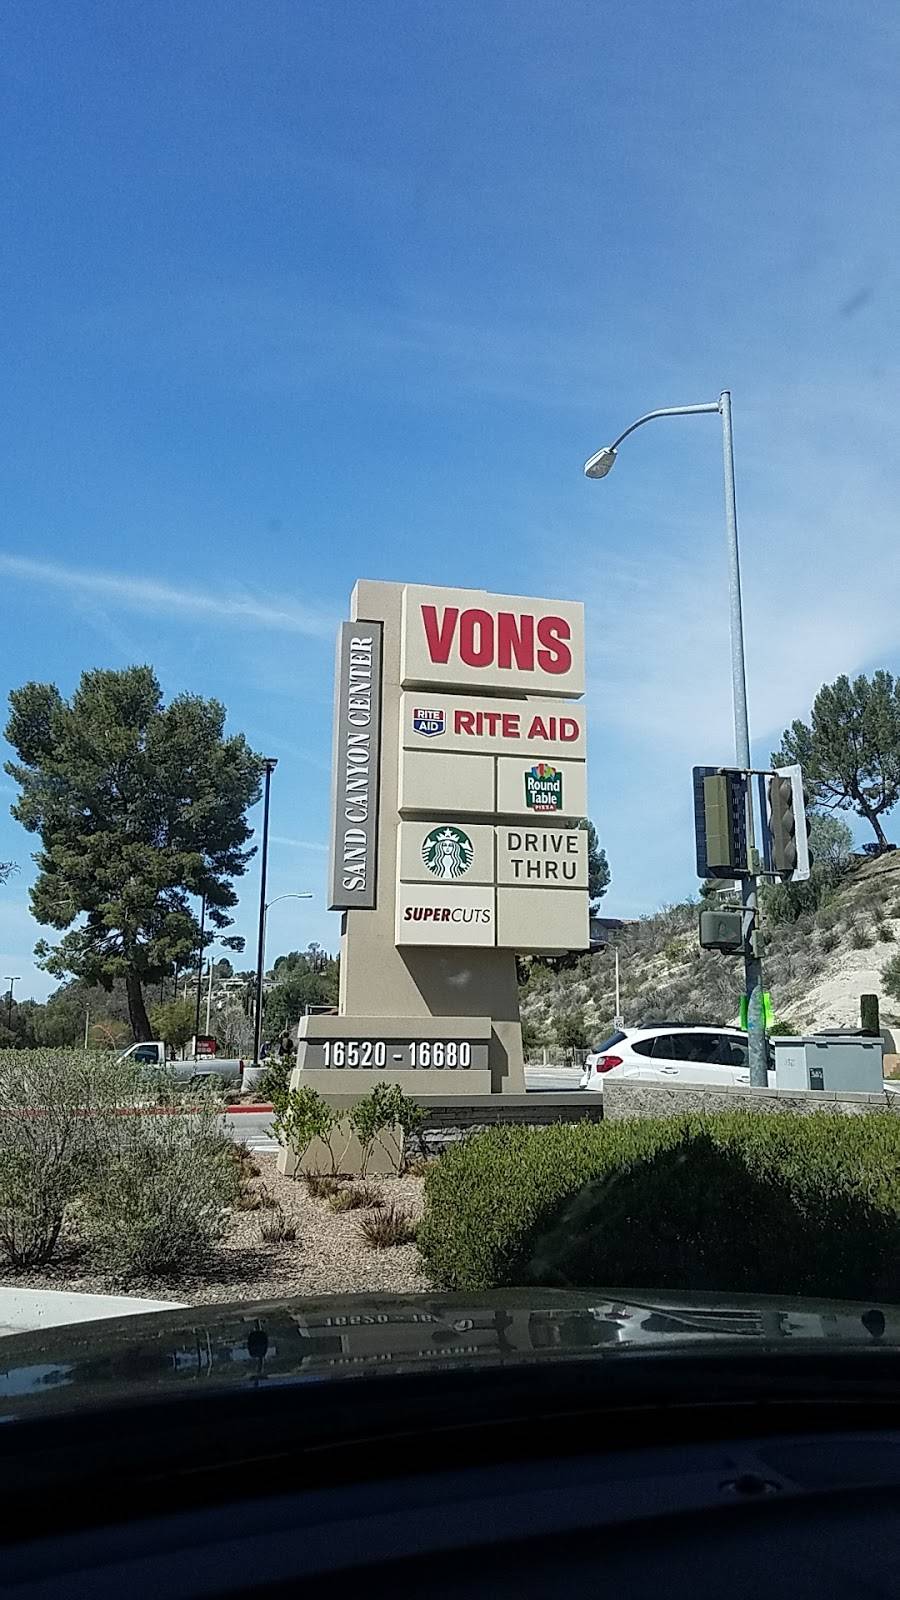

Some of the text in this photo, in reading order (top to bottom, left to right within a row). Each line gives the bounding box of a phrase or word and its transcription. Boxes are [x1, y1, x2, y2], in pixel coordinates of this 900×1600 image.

[421, 604, 573, 676] VONS
[417, 710, 440, 720] RITE
[418, 720, 439, 731] AID
[454, 710, 580, 742] RITE AID
[343, 637, 373, 892] SAND CANYON CENTER
[527, 777, 560, 792] Round
[529, 790, 558, 804] Table
[507, 832, 579, 854] DRIVE
[511, 859, 577, 880] THRU
[404, 906, 491, 924] SUPERCUTS
[322, 1041, 387, 1067] 16520
[408, 1042, 471, 1067] 16680
